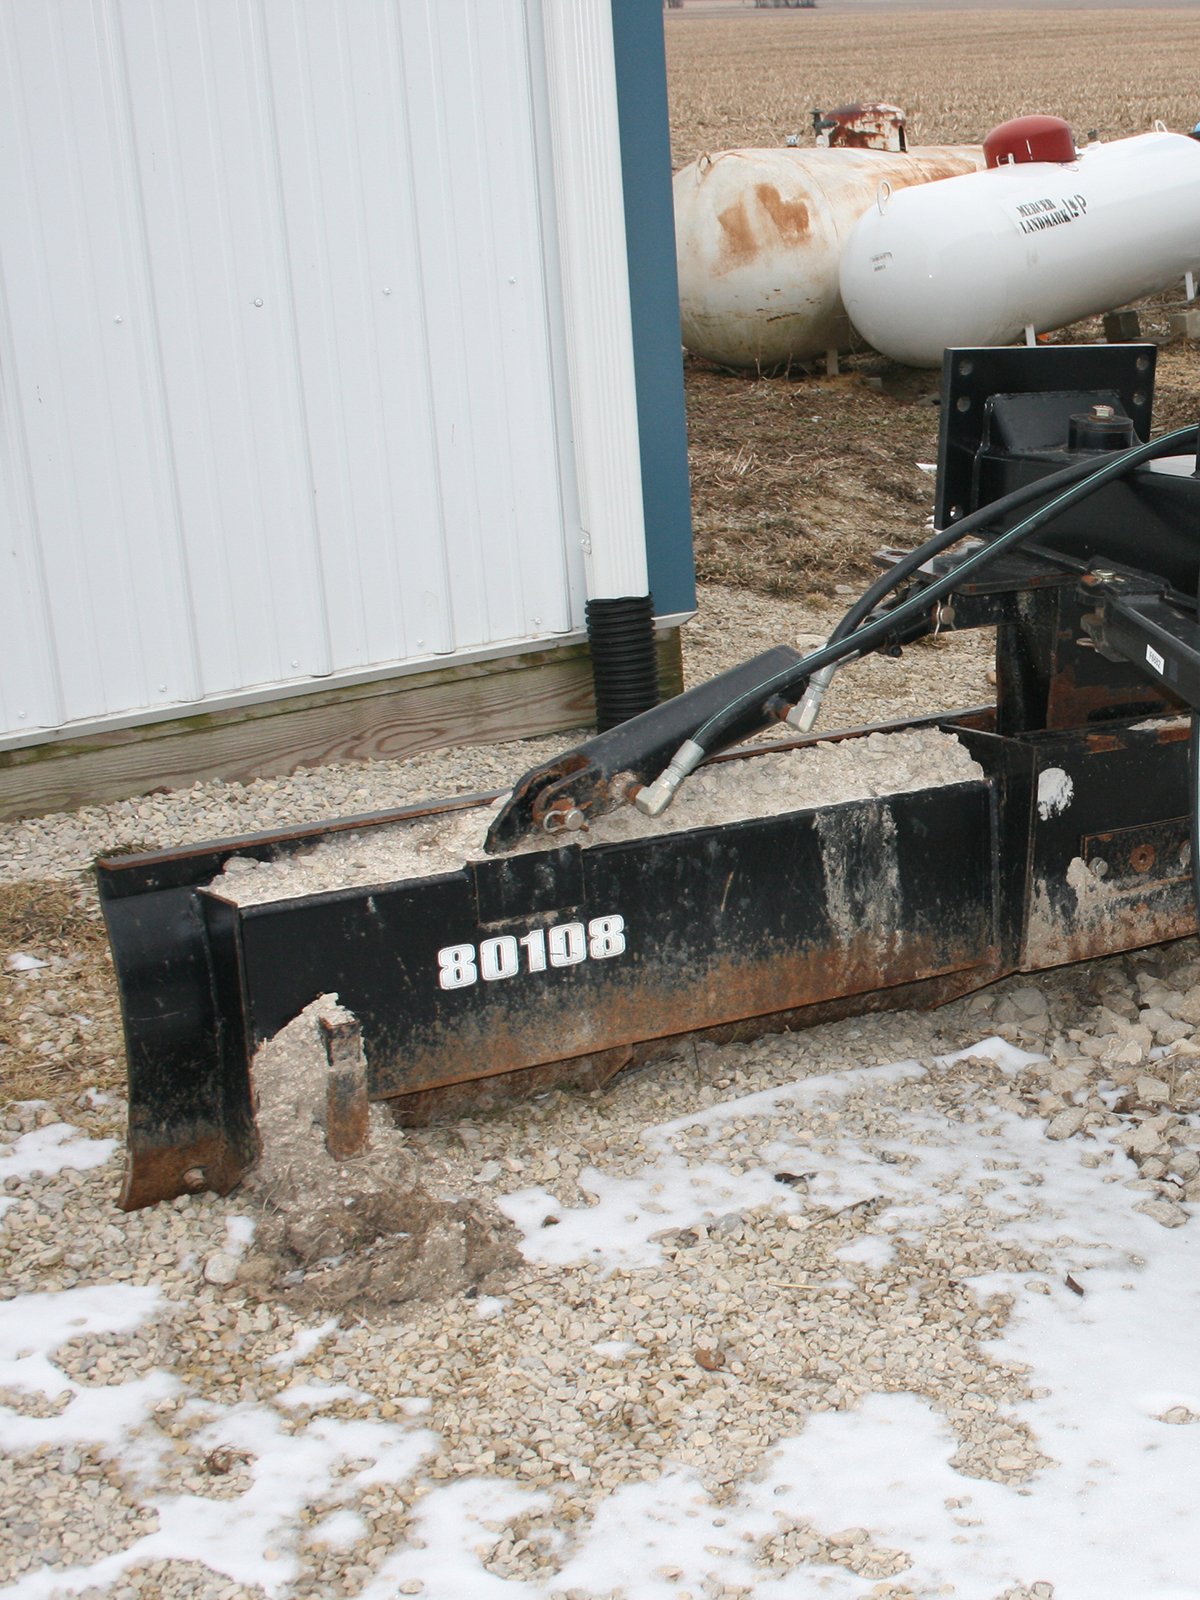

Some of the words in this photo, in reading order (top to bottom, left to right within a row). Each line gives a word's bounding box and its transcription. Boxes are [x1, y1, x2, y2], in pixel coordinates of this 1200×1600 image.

[1016, 198, 1056, 217] MERCER
[1019, 209, 1071, 234] LANDMARK
[437, 914, 627, 990] 80108
